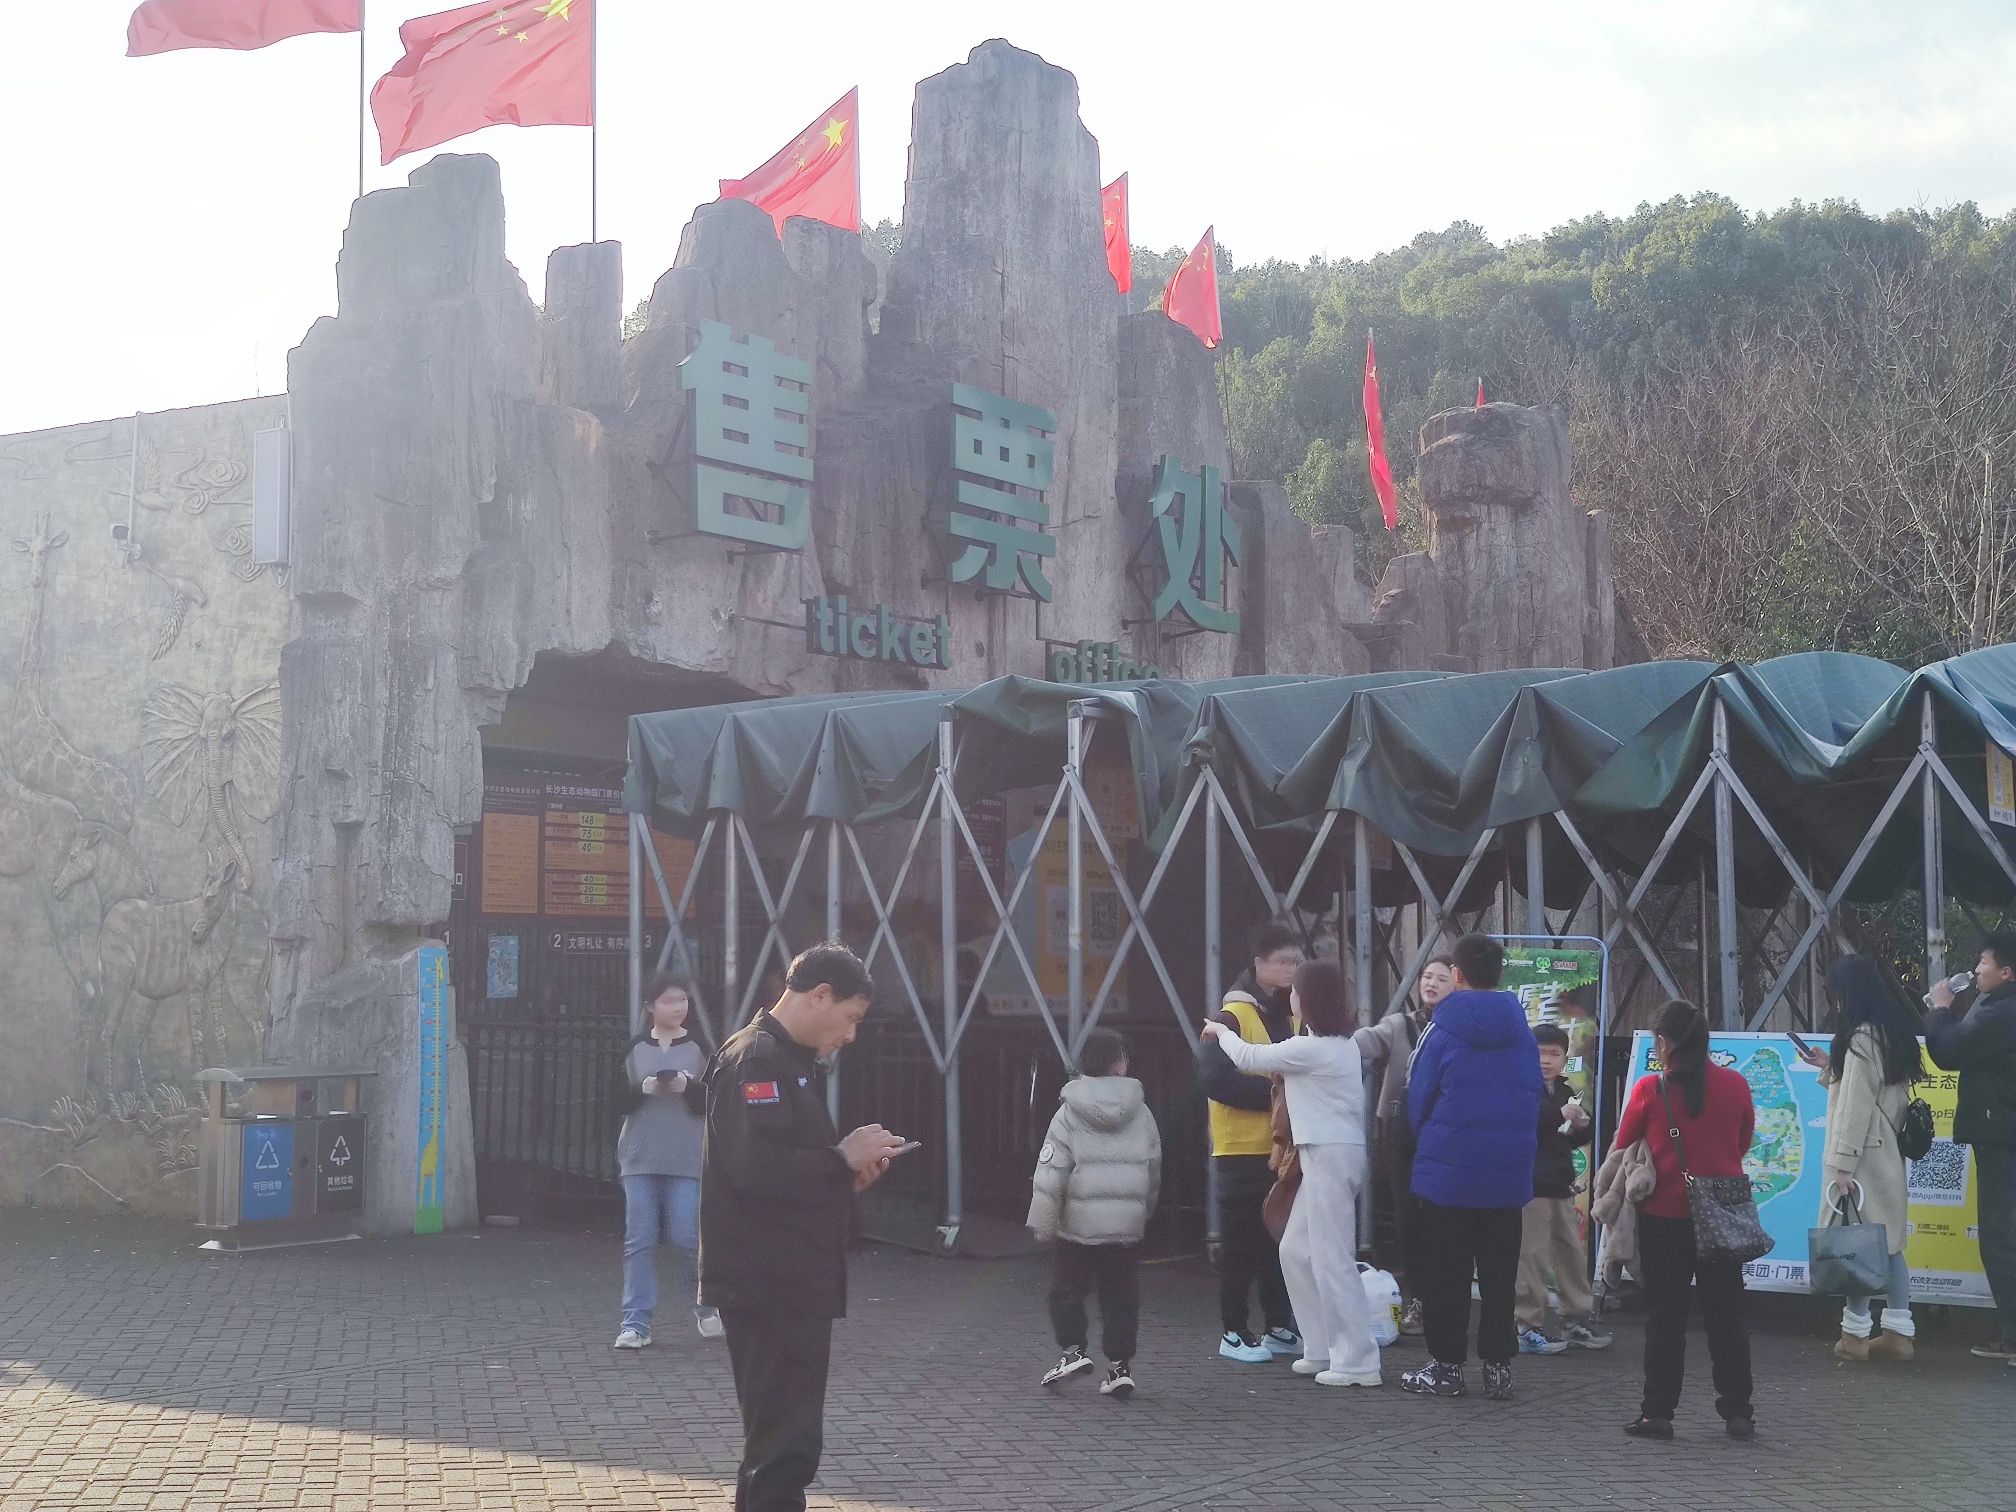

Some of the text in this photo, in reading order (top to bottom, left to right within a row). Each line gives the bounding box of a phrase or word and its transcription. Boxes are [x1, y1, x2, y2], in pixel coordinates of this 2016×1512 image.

[677, 319, 1240, 634] 售票处
[816, 594, 953, 668] ticket
[581, 815, 594, 825] 148
[582, 828, 592, 838] 75
[581, 842, 592, 853] 40
[583, 875, 594, 883] 40
[583, 885, 594, 893] 20
[553, 933, 562, 949] 2
[568, 936, 603, 950] 文明礼让
[645, 935, 652, 949] 3
